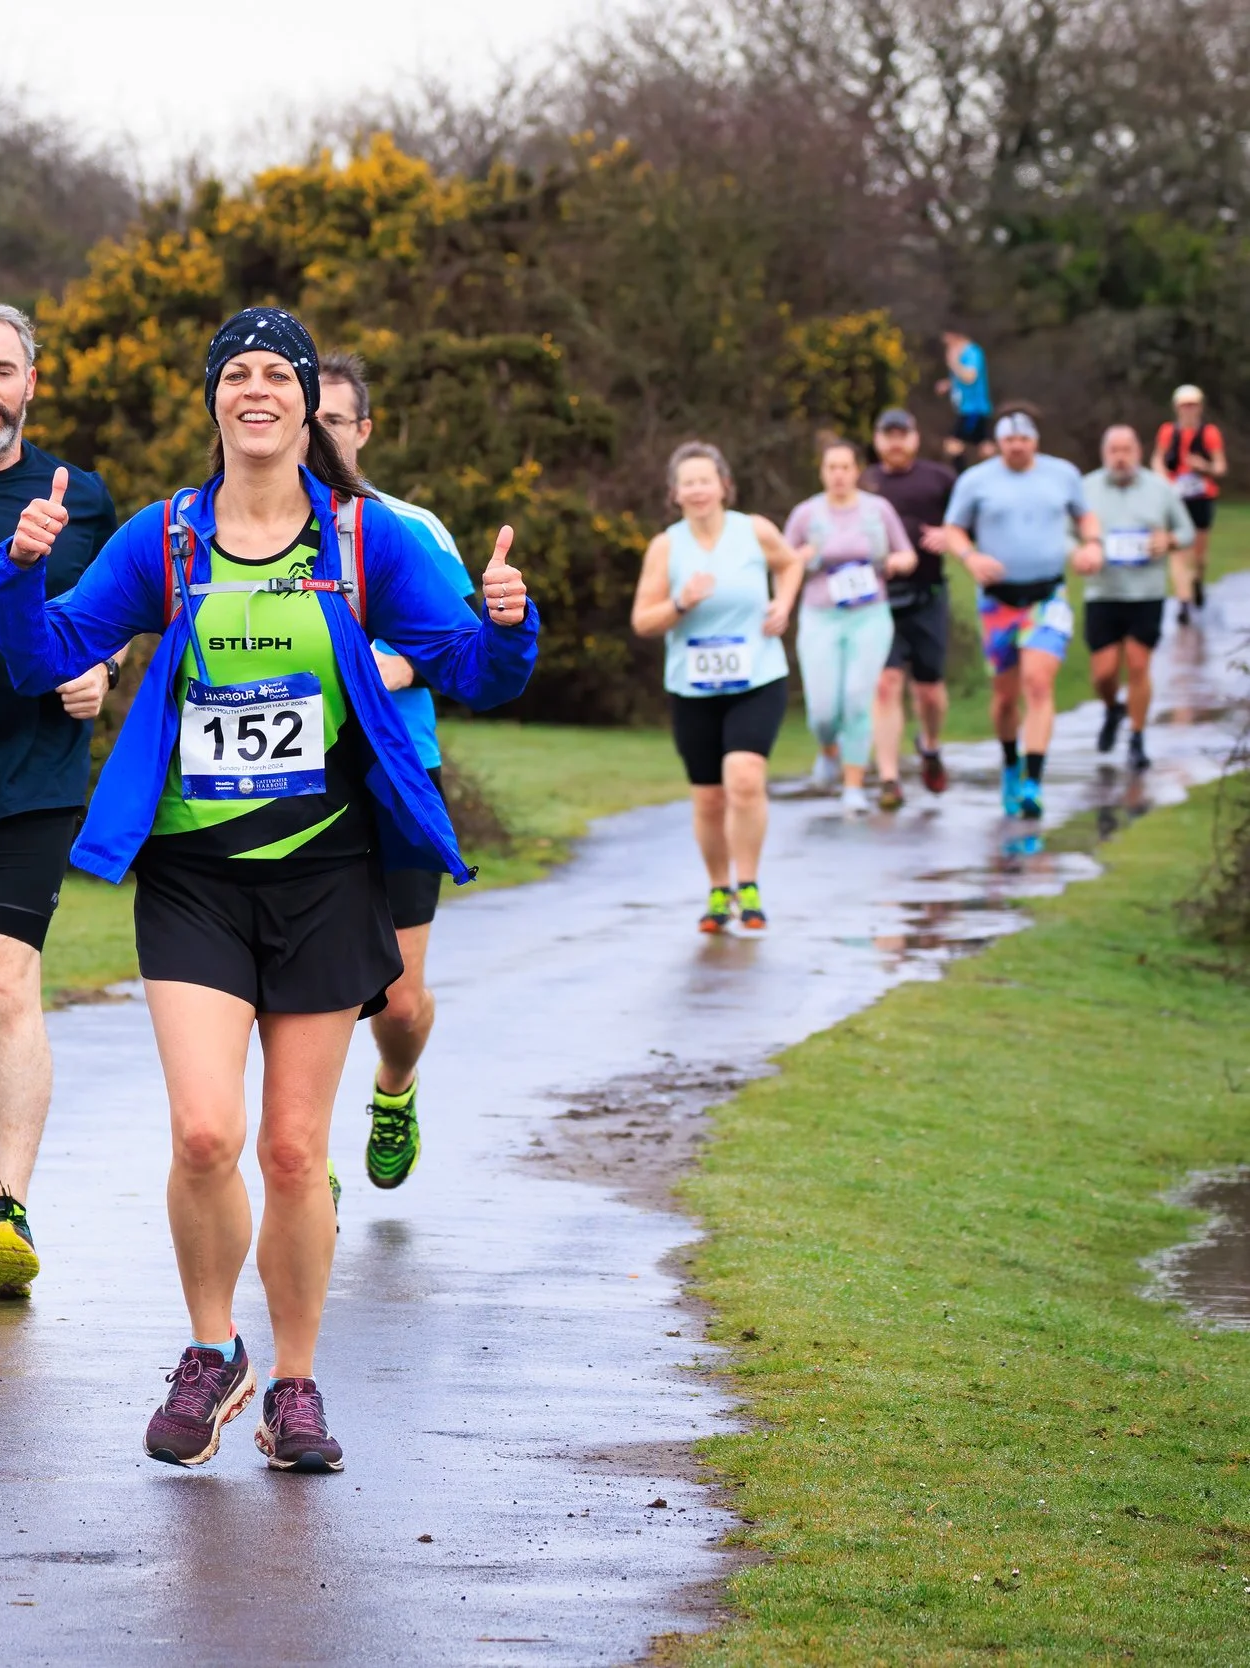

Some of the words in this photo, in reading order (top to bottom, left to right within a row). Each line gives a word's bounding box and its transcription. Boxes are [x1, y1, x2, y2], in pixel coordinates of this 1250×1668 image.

[208, 637, 292, 651] STEPH
[204, 690, 256, 701] HARBOUR
[207, 706, 239, 715] PLYMOUTH
[239, 704, 272, 714] HARBOUR
[203, 710, 303, 762] 152
[218, 764, 241, 772] Sunday
